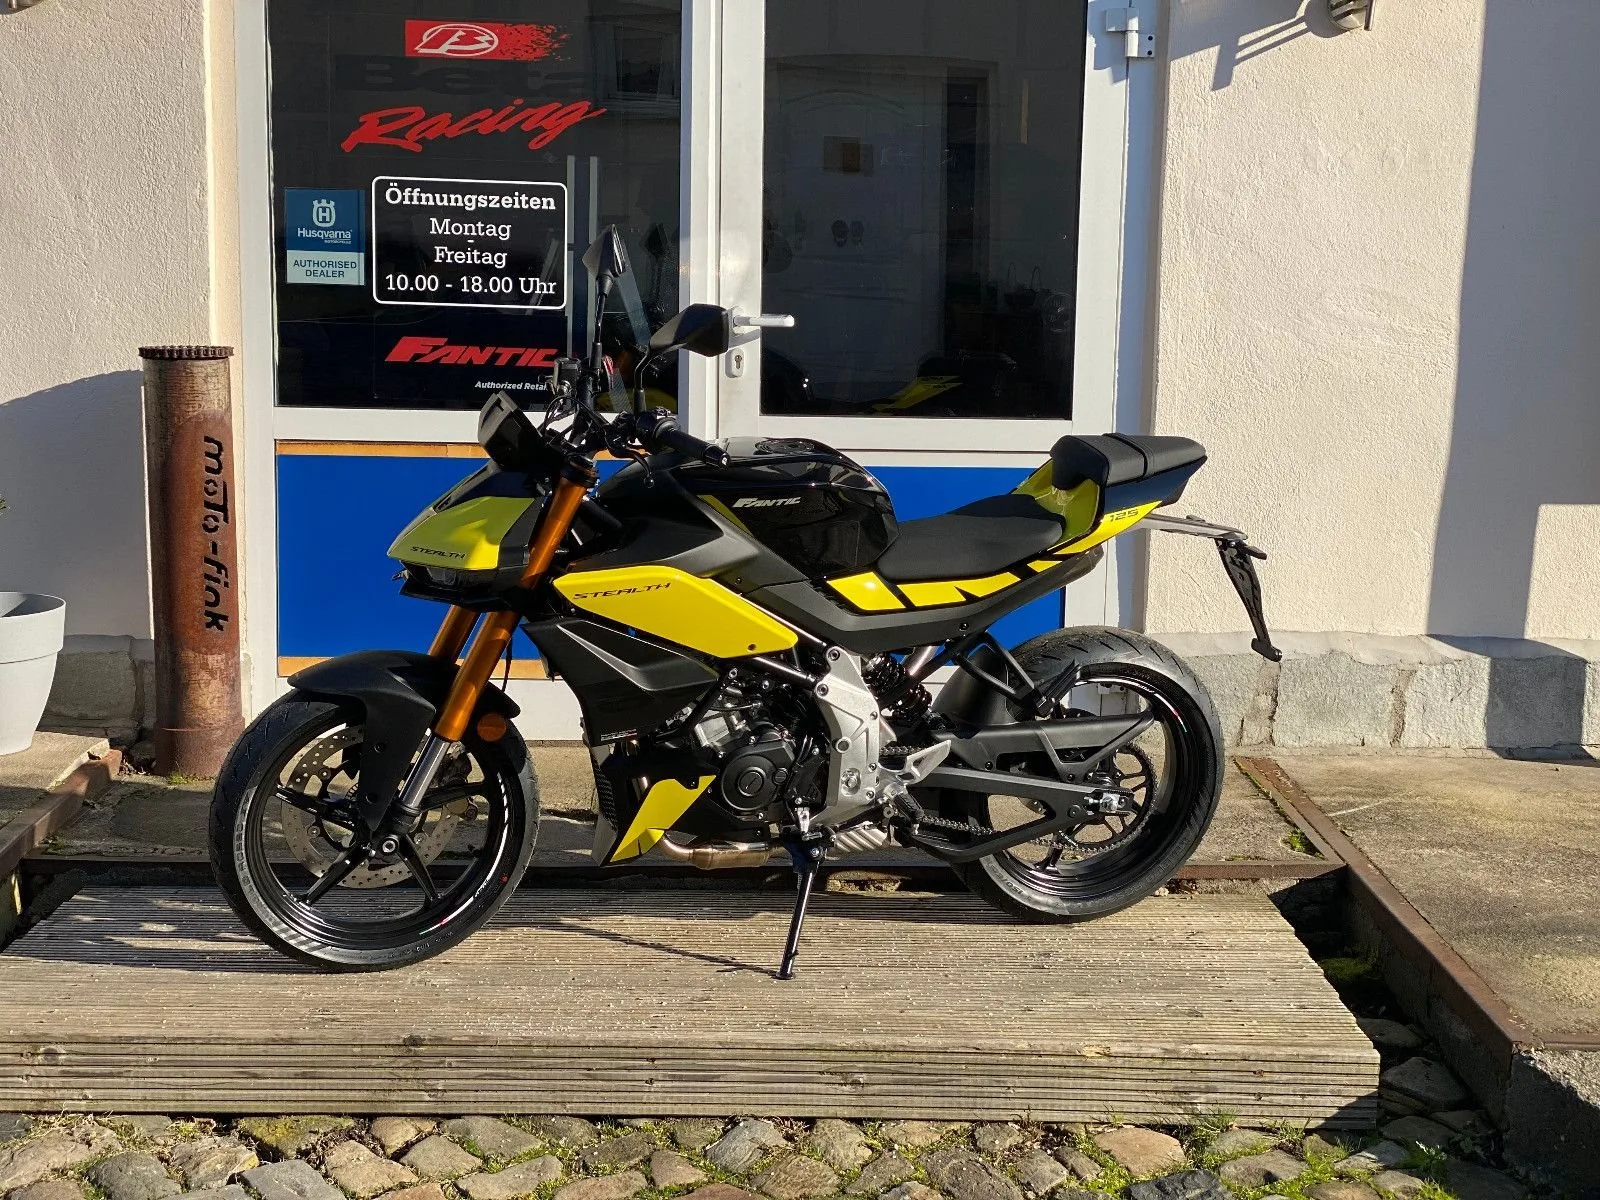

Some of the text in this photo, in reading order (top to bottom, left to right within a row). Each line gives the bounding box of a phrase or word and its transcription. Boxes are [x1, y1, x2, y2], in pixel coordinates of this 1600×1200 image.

[341, 98, 608, 153] Racing
[385, 182, 556, 211] Öffnungszeiten
[297, 227, 352, 240] Husqvarna
[429, 217, 512, 241] Montag
[293, 259, 357, 269] AUTHORISED
[434, 246, 508, 269] Freitag
[305, 269, 345, 278] DEALER
[385, 274, 439, 292] 10.00
[460, 276, 513, 293] 18.00
[518, 277, 557, 294] Uhr
[384, 336, 559, 368] FANTIC
[474, 380, 523, 391] Authorized
[1109, 508, 1139, 522] 125
[411, 546, 466, 559] STEALTH
[573, 582, 671, 600] STEALTH
